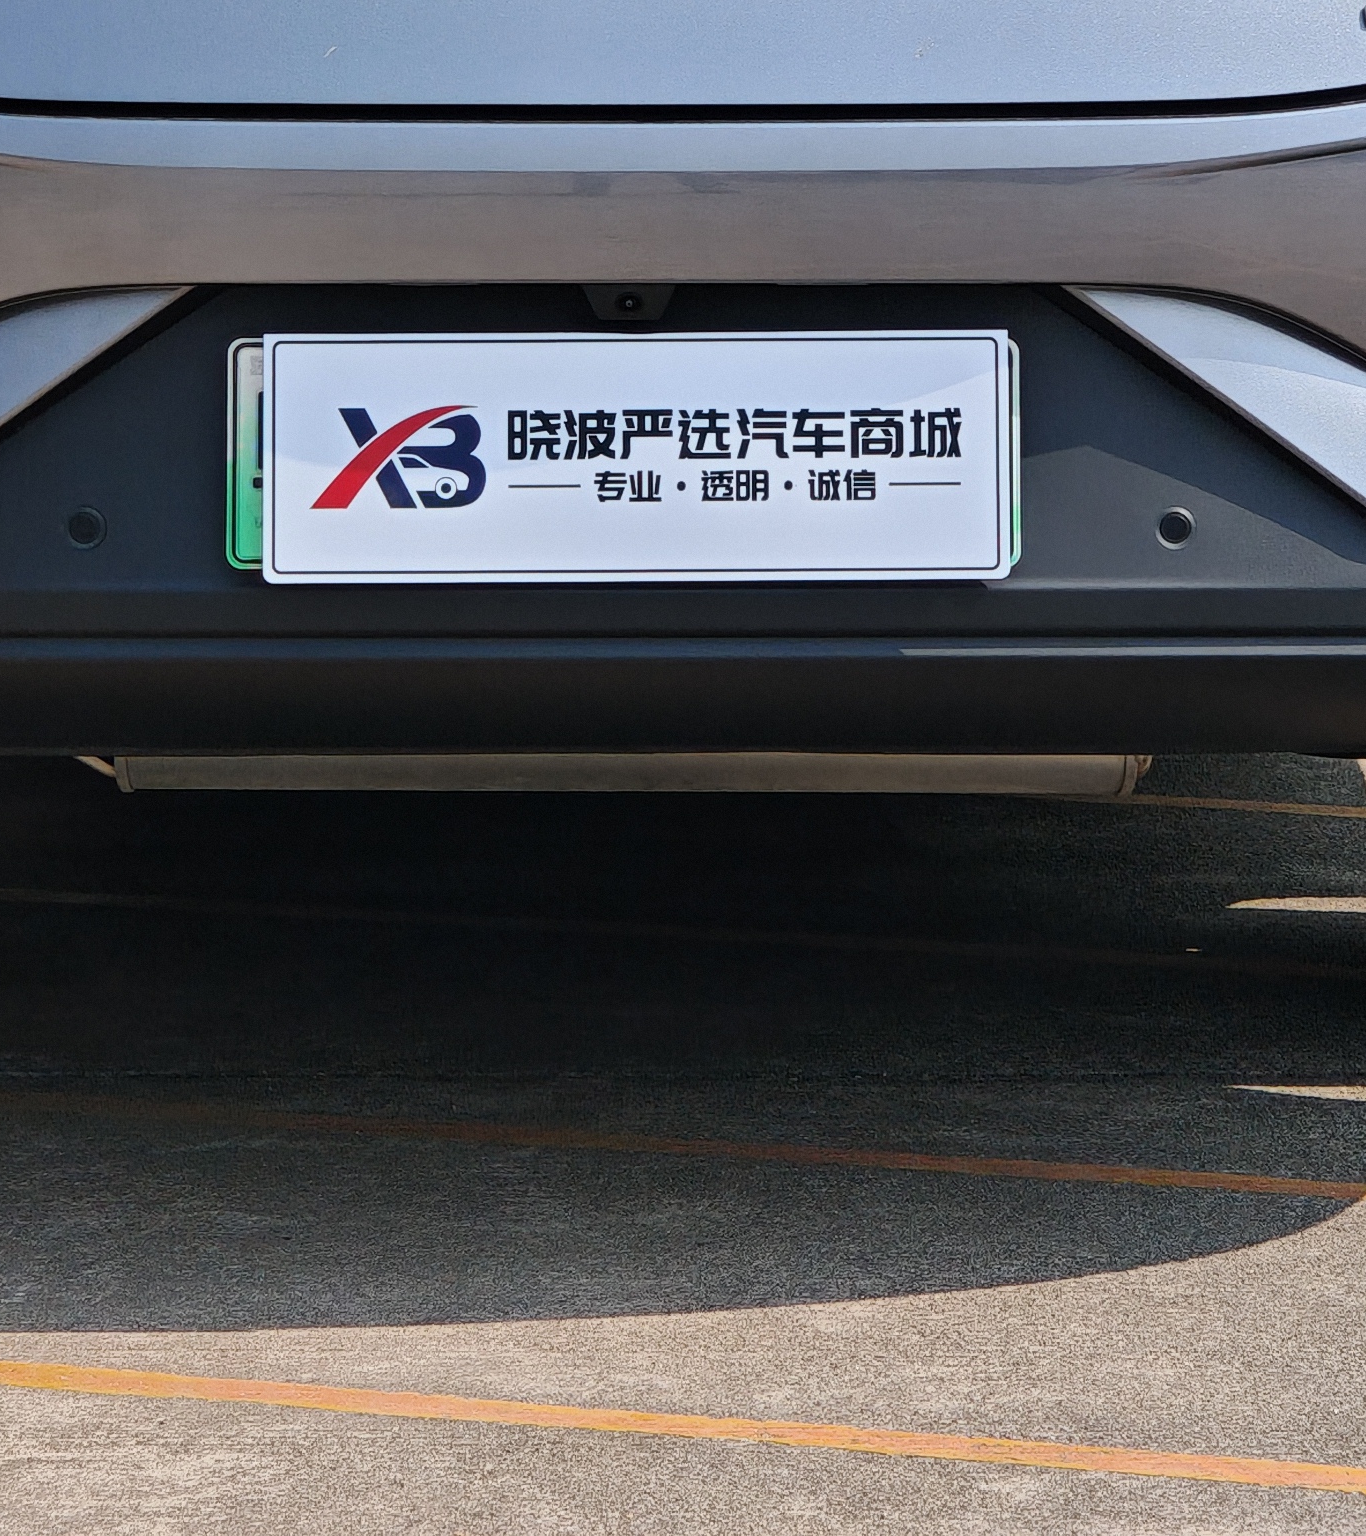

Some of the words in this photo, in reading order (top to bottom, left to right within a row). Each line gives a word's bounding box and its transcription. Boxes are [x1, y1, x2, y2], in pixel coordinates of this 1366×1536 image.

[507, 407, 963, 460] 晓波严选汽车商城
